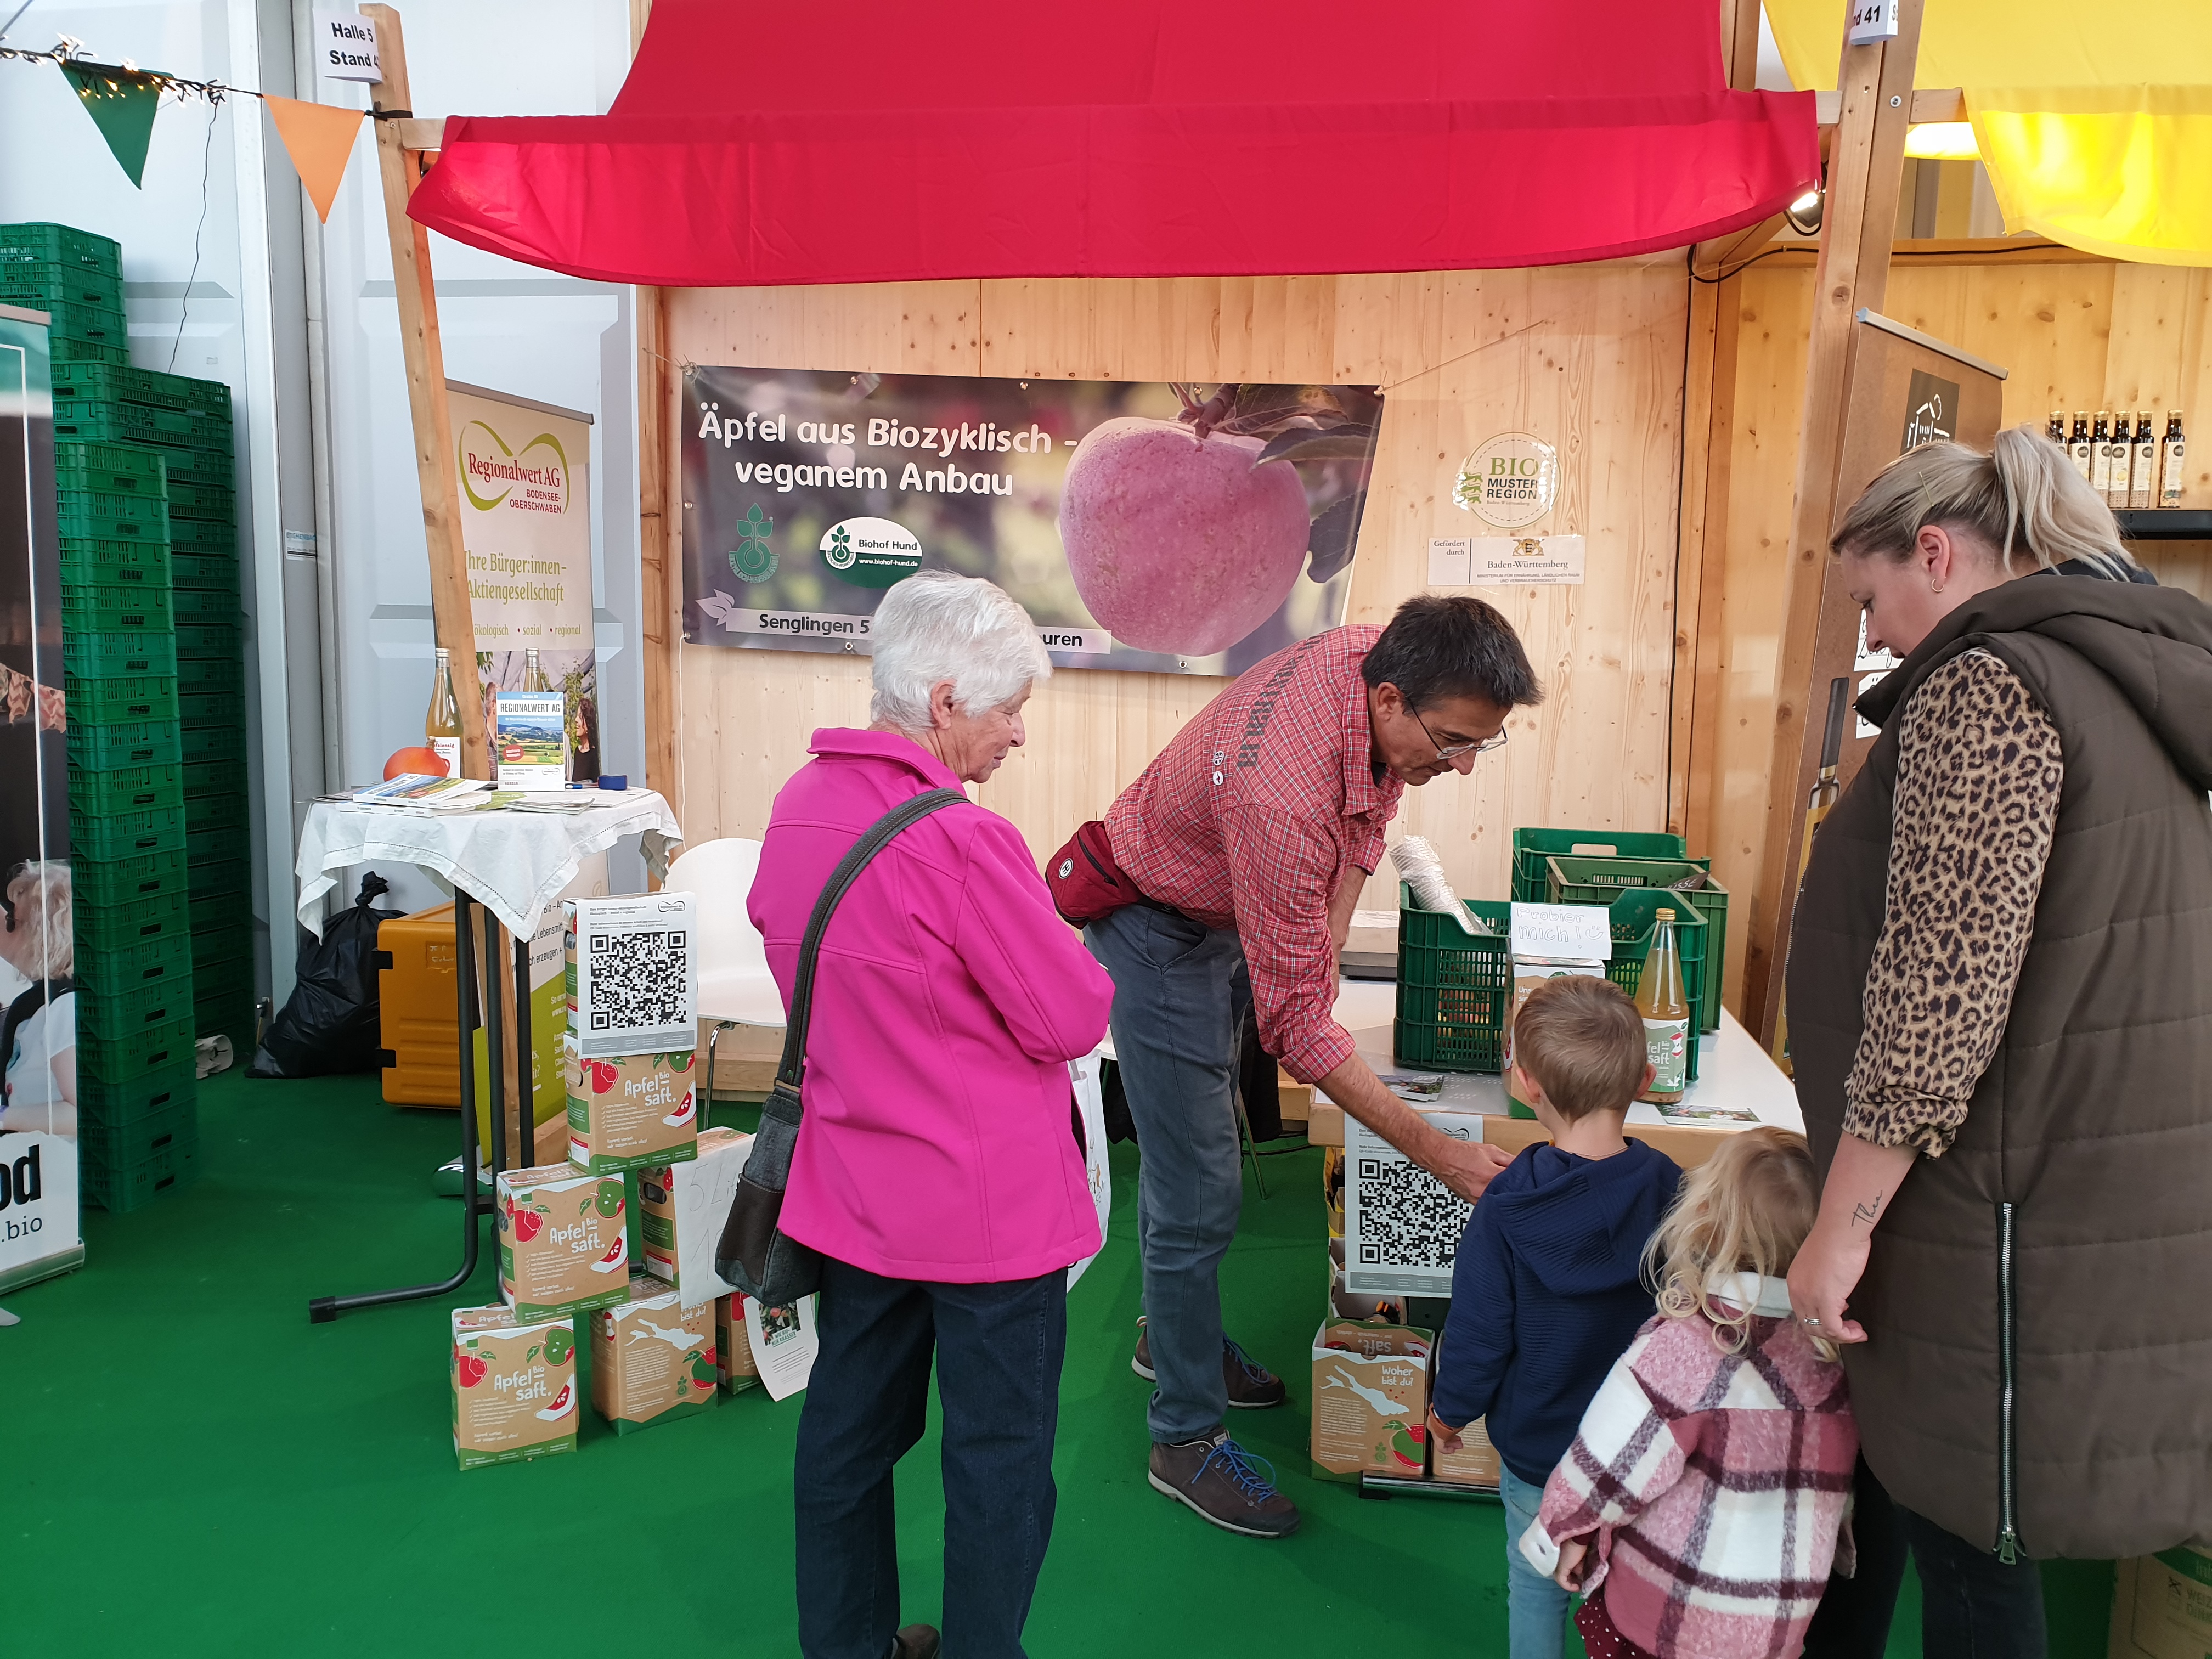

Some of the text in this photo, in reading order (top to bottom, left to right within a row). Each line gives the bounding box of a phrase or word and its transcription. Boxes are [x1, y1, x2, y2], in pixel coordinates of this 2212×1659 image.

[1864, 5, 1881, 24] 41
[331, 22, 373, 42] Halle 5
[329, 50, 372, 67] Stand
[698, 402, 786, 449] Äpfel
[797, 421, 855, 445] aus
[867, 418, 1051, 458] Biozyklisch
[467, 453, 560, 487] Regionalwert AG
[1489, 457, 1539, 477] BIO
[735, 460, 1013, 496] veganem Anbau
[526, 489, 561, 502] BODENSEE-
[1487, 489, 1537, 499] REGION
[510, 499, 562, 514] OBERSCHWABEN
[859, 539, 917, 550] Biohof Hund
[465, 550, 567, 578] Ihre Bürger:innen-
[859, 558, 918, 567] www.biohof-hund.de
[1487, 560, 1568, 570] Baden-Württemberg
[467, 579, 564, 606] Aktiengesellschaft
[474, 624, 581, 639] ökologisch sozial regional
[759, 613, 854, 635] Senglingen
[500, 703, 560, 713] REGIONALWERT AG
[1517, 908, 1584, 923] Probier
[1519, 922, 1569, 942] mich
[537, 949, 558, 963] erzeugen
[1648, 1052, 1669, 1065] saft
[625, 1071, 670, 1098] Apfel Bio
[645, 1087, 676, 1107] saft.
[690, 1164, 709, 1212] 5
[550, 1217, 597, 1245] Apfel Bio
[571, 1234, 605, 1254] saft.
[681, 1311, 693, 1322] bist
[696, 1306, 707, 1317] du?
[494, 1365, 545, 1393] Apfel Bio
[1381, 1365, 1414, 1376] Woher
[516, 1380, 552, 1401] saft.
[1381, 1376, 1414, 1386] bist du?
